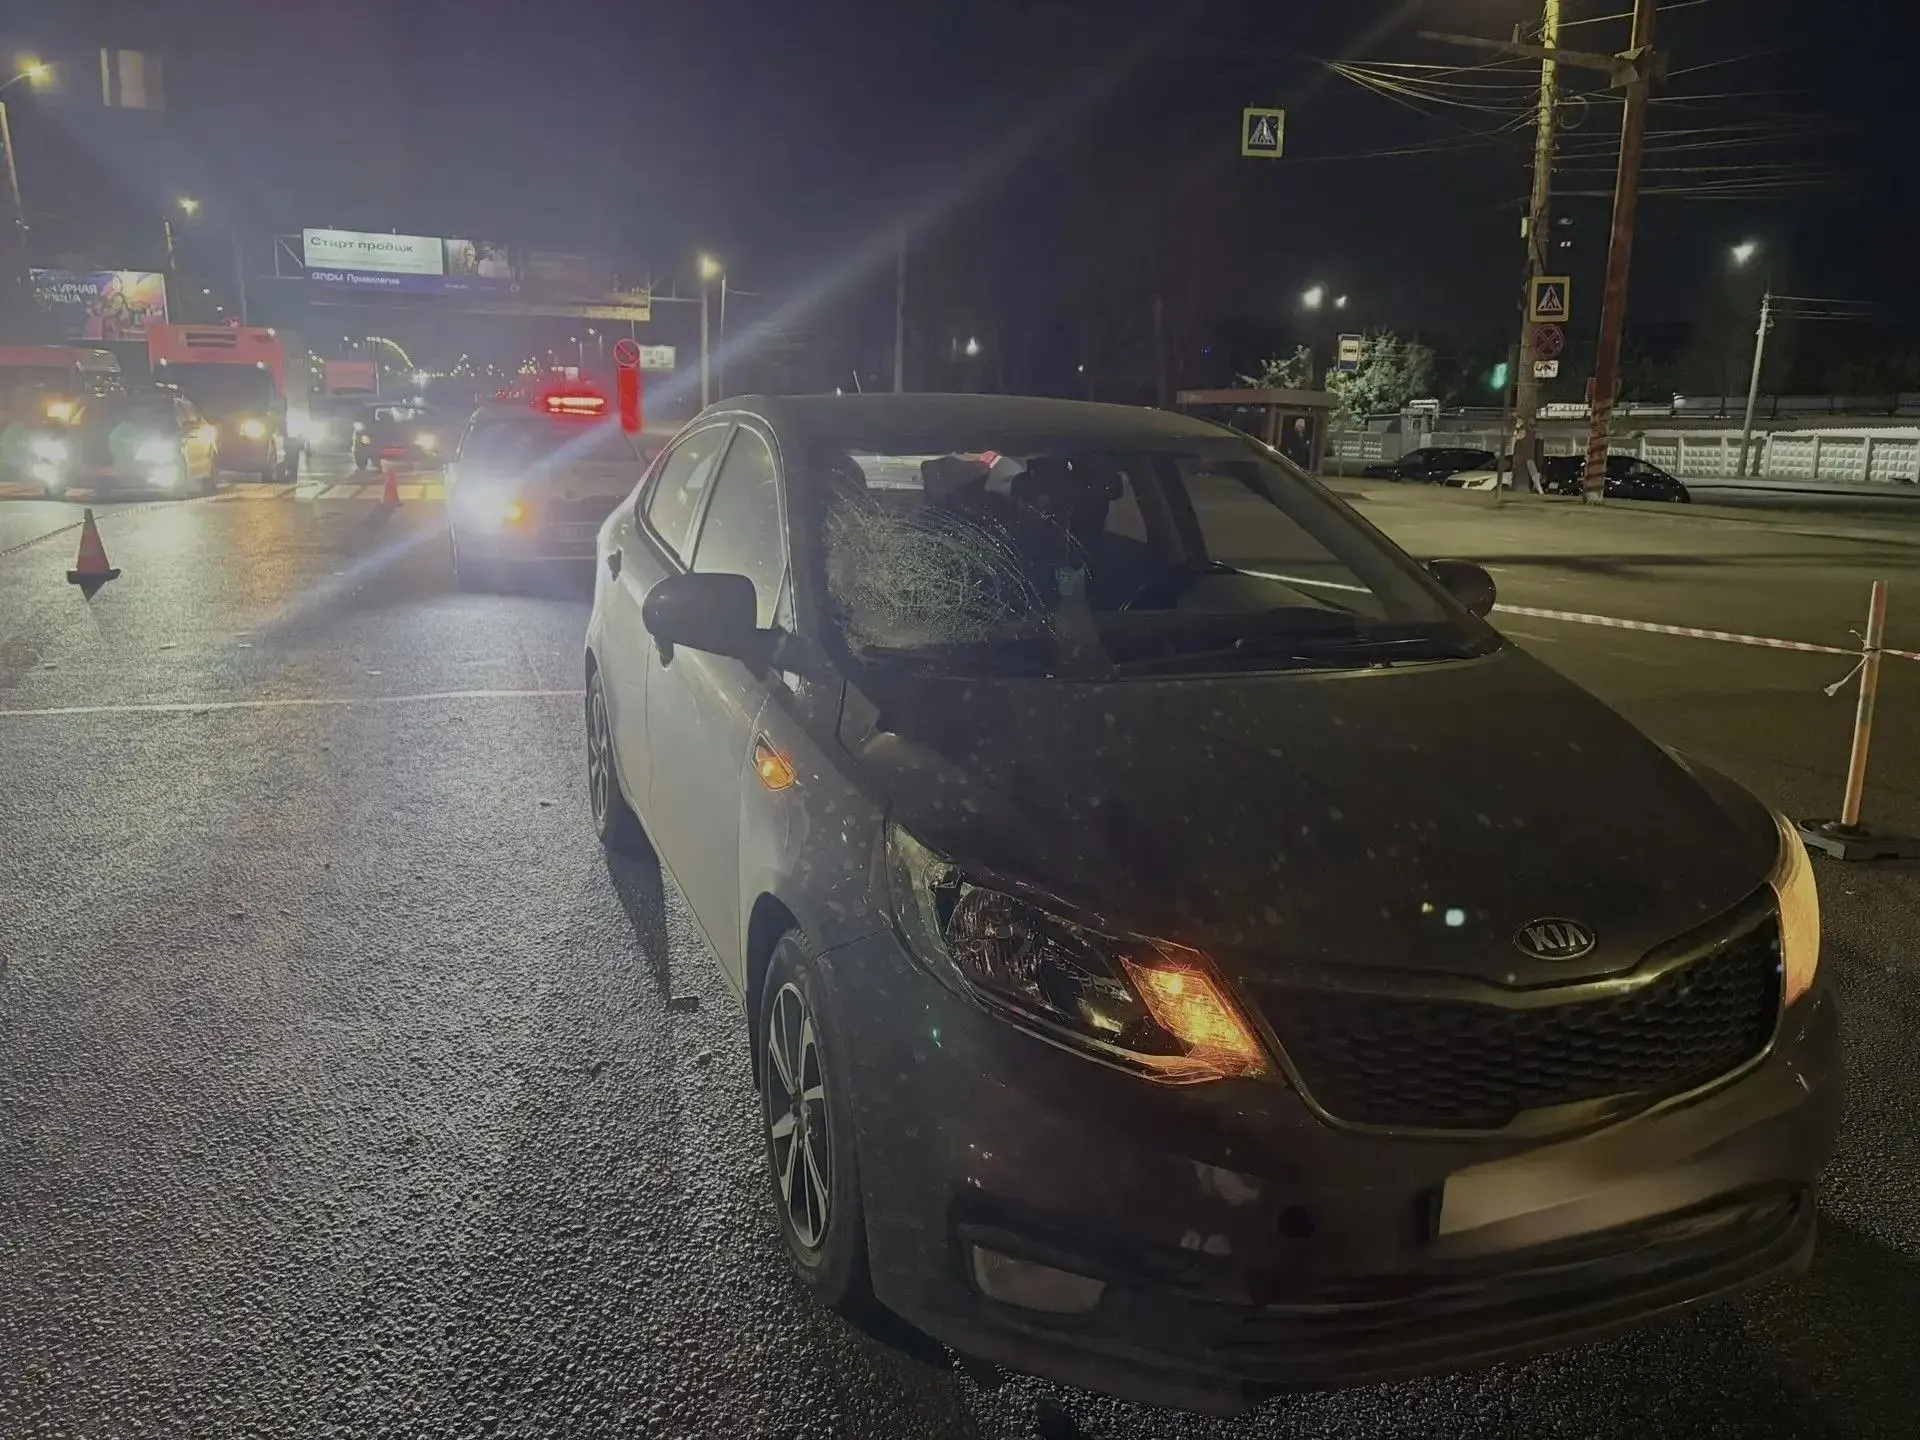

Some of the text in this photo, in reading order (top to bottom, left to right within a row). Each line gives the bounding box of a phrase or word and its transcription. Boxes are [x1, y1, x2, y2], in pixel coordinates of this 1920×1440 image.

[310, 236, 413, 253] Старт продаж
[1524, 922, 1588, 951] KIA
